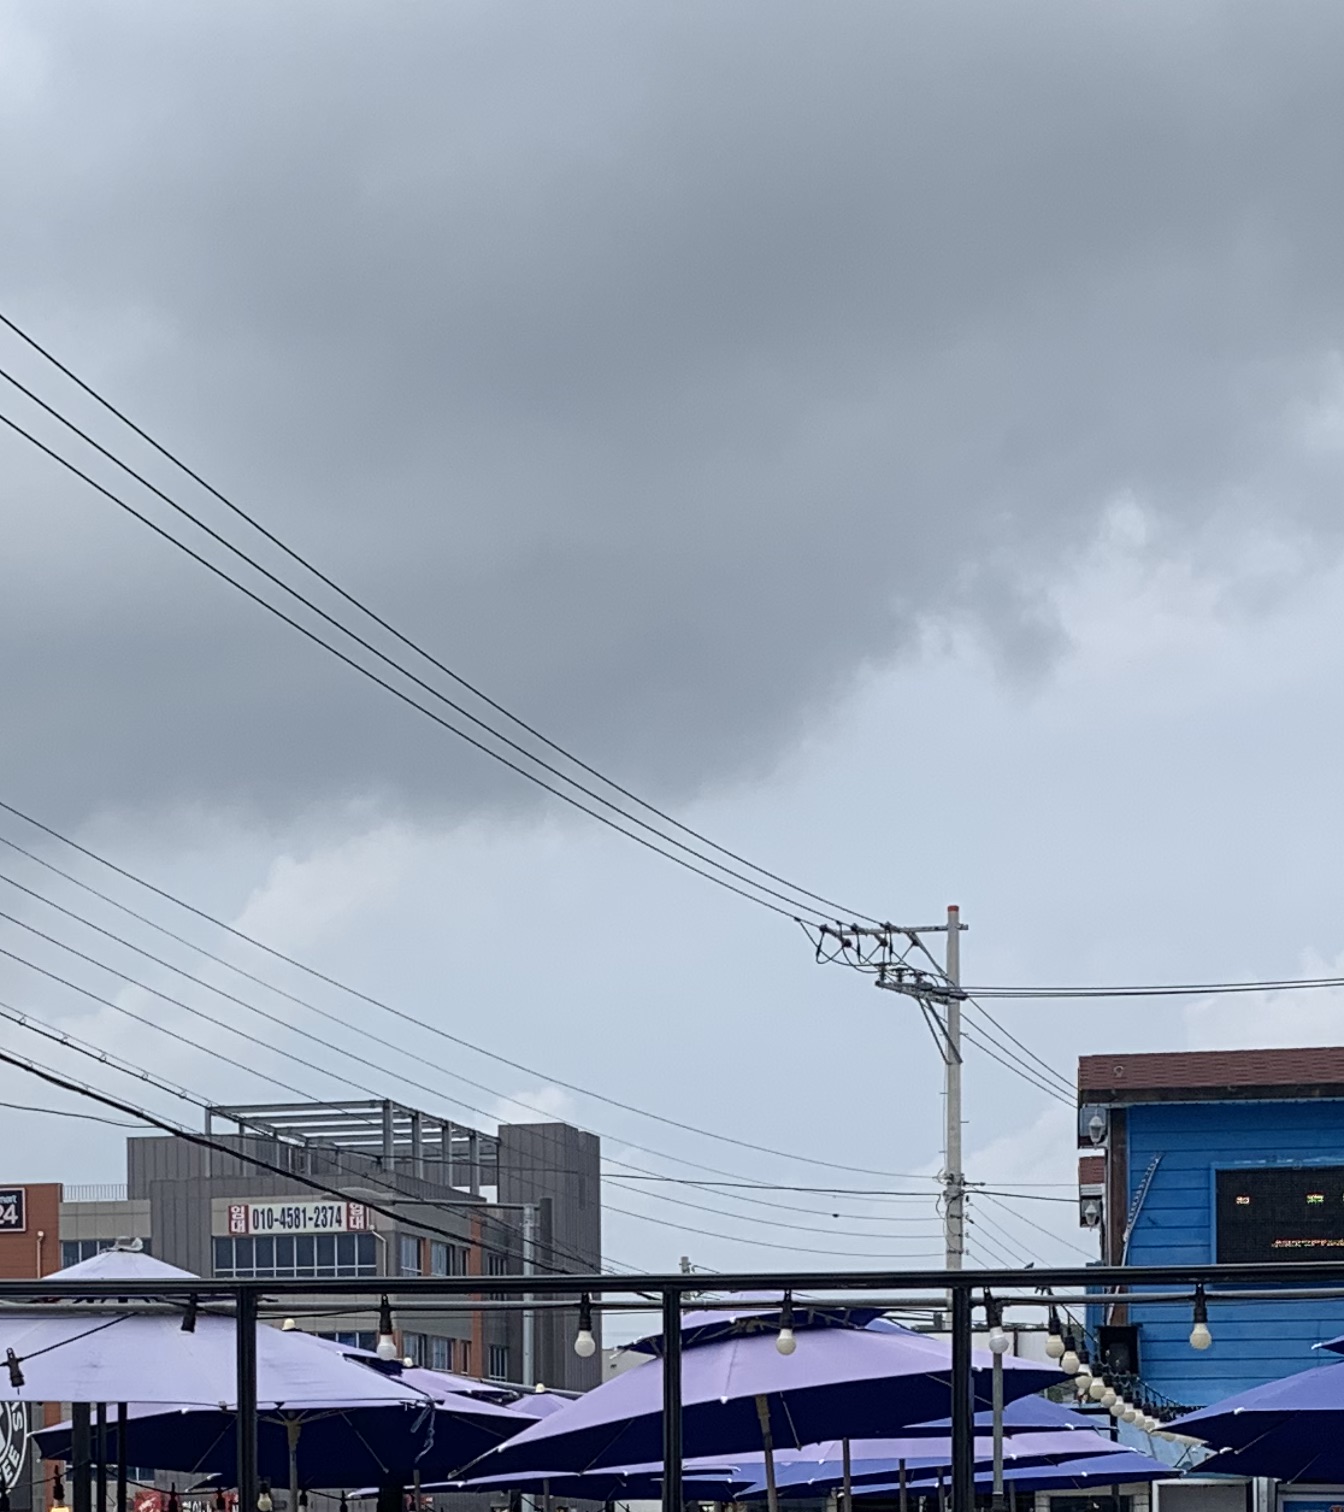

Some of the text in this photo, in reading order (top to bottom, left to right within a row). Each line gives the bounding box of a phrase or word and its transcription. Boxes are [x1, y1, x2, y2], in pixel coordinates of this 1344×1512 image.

[231, 1206, 245, 1232] 임대
[253, 1206, 342, 1230] 010-4581-2374
[349, 1202, 364, 1229] 임대
